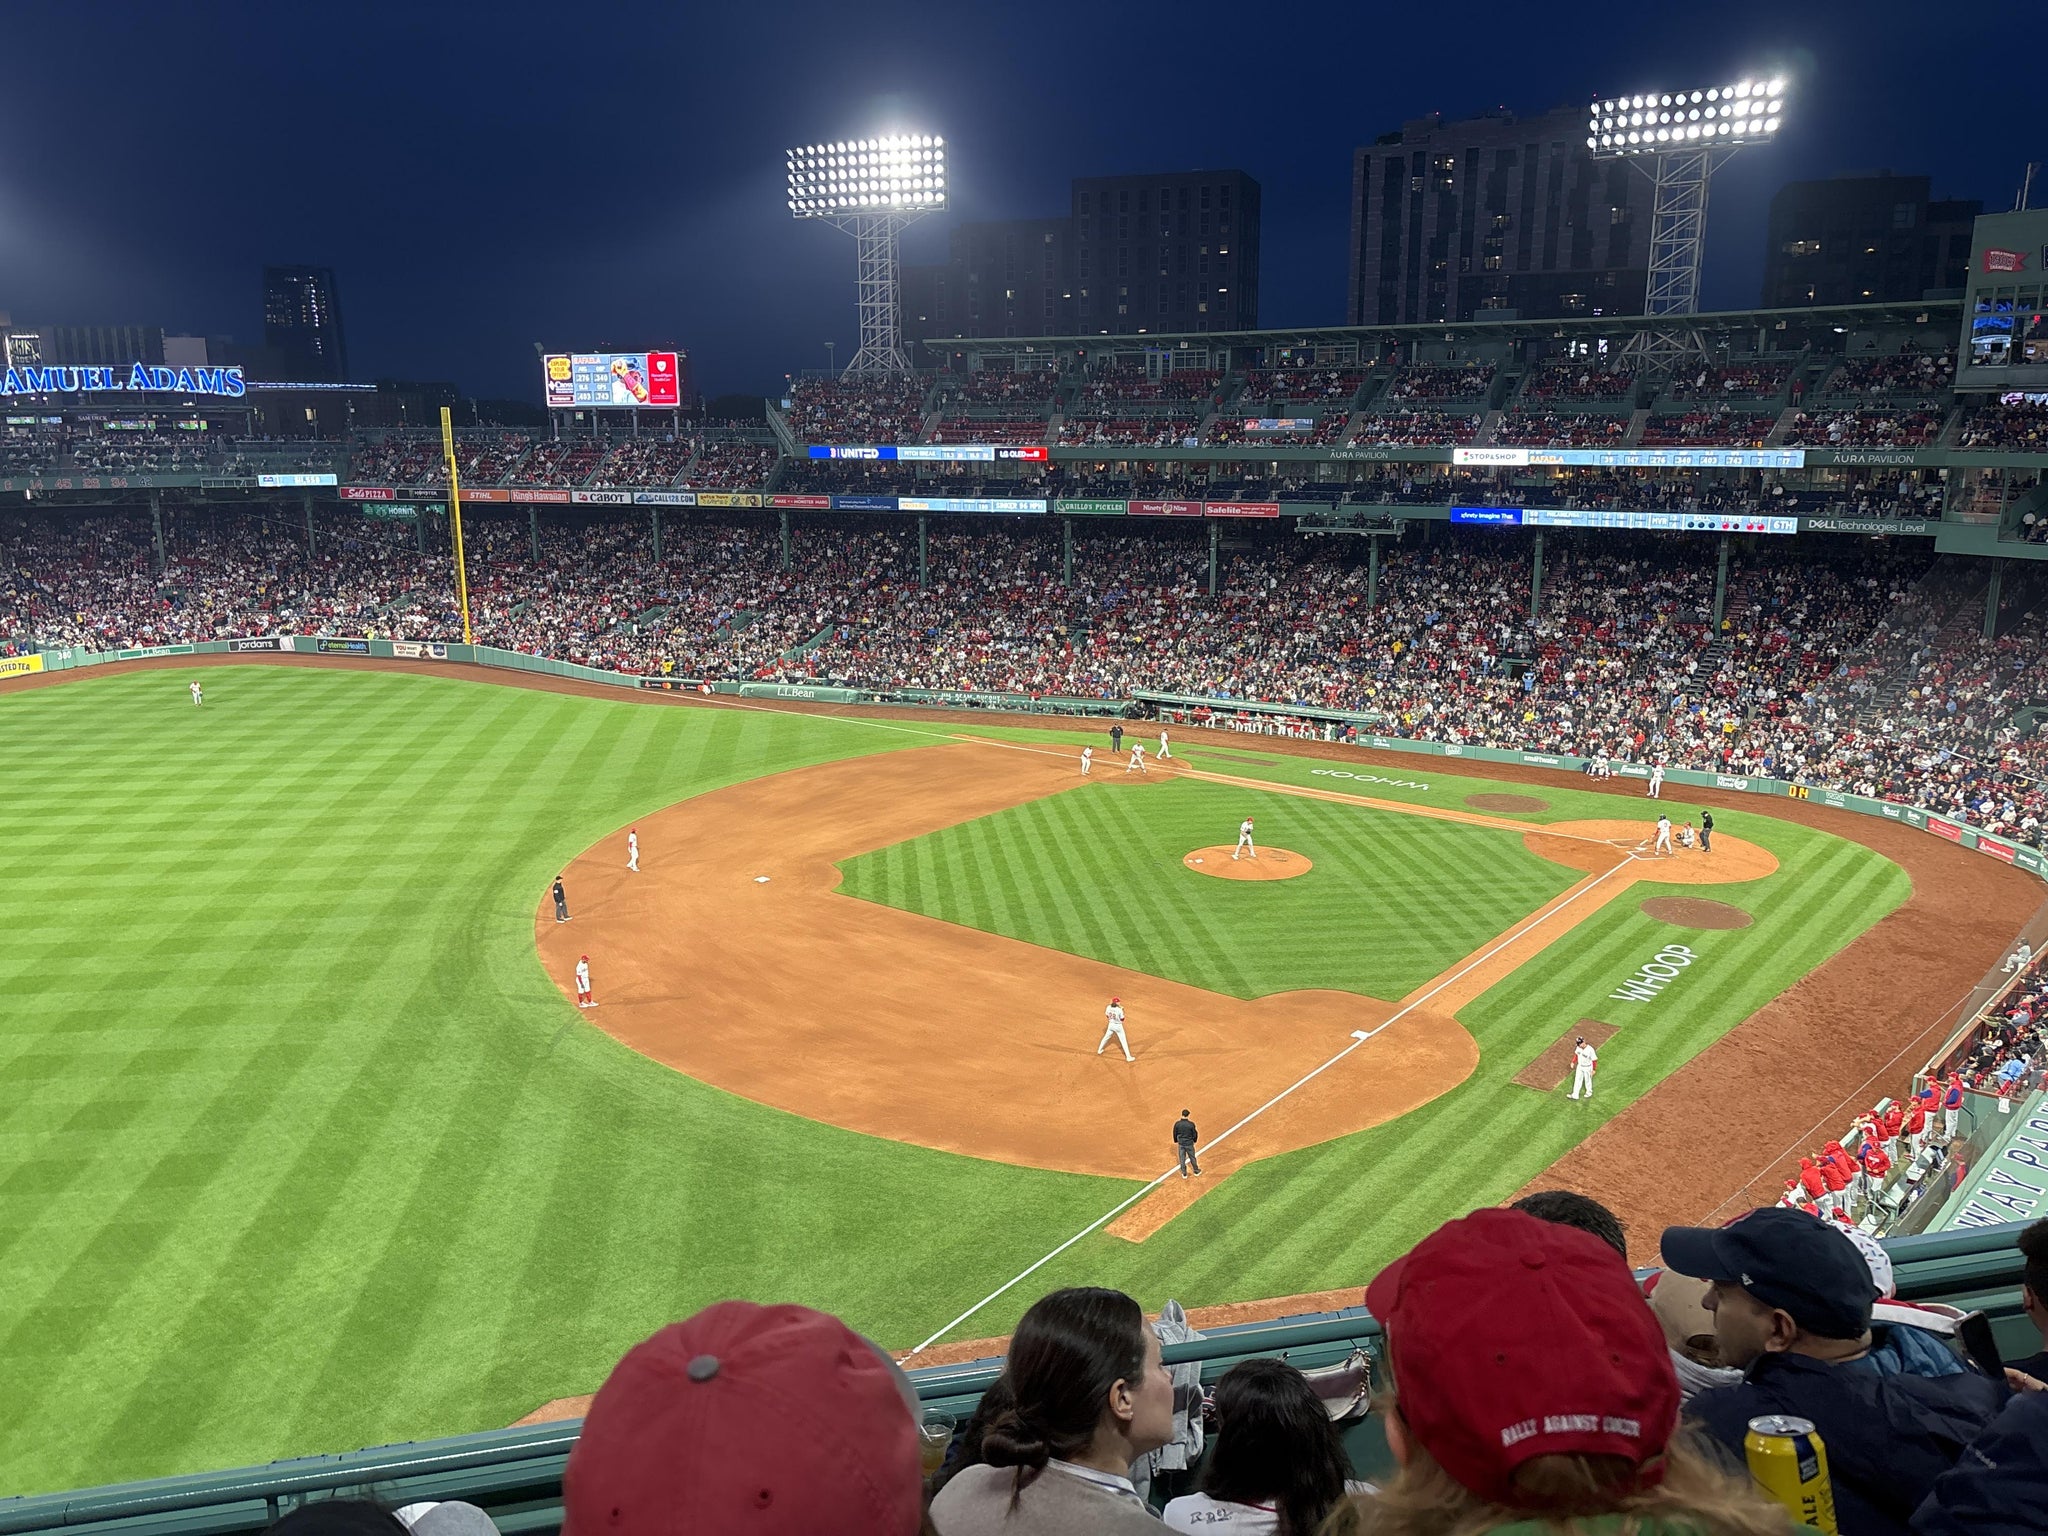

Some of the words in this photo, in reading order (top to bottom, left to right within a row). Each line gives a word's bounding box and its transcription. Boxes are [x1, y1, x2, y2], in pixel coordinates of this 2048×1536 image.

[0, 366, 123, 396] AMUEL
[126, 361, 246, 397] ADAMS
[840, 448, 879, 458] UNITED
[1868, 454, 1914, 464] PAVILION
[140, 477, 153, 486] 42
[366, 490, 387, 498] PIZZA
[512, 490, 533, 500] King's
[534, 491, 567, 500] Hawaiian
[654, 494, 694, 502] CALL128.COM
[1773, 520, 1792, 530] 6TH
[1808, 520, 1836, 529] DELL
[1836, 520, 1898, 533] Technologies
[1900, 522, 1926, 533] Level
[57, 651, 72, 660] 380
[0, 663, 16, 672] STED
[18, 662, 30, 671] TEA
[1311, 769, 1428, 790] WHOOP
[1609, 944, 1699, 1002] WHOOP
[1947, 1167, 2047, 1230] WAY
[1500, 1417, 1538, 1448] RALLY
[1544, 1414, 1599, 1434] AGAINST
[1802, 1495, 1820, 1526] ALE
